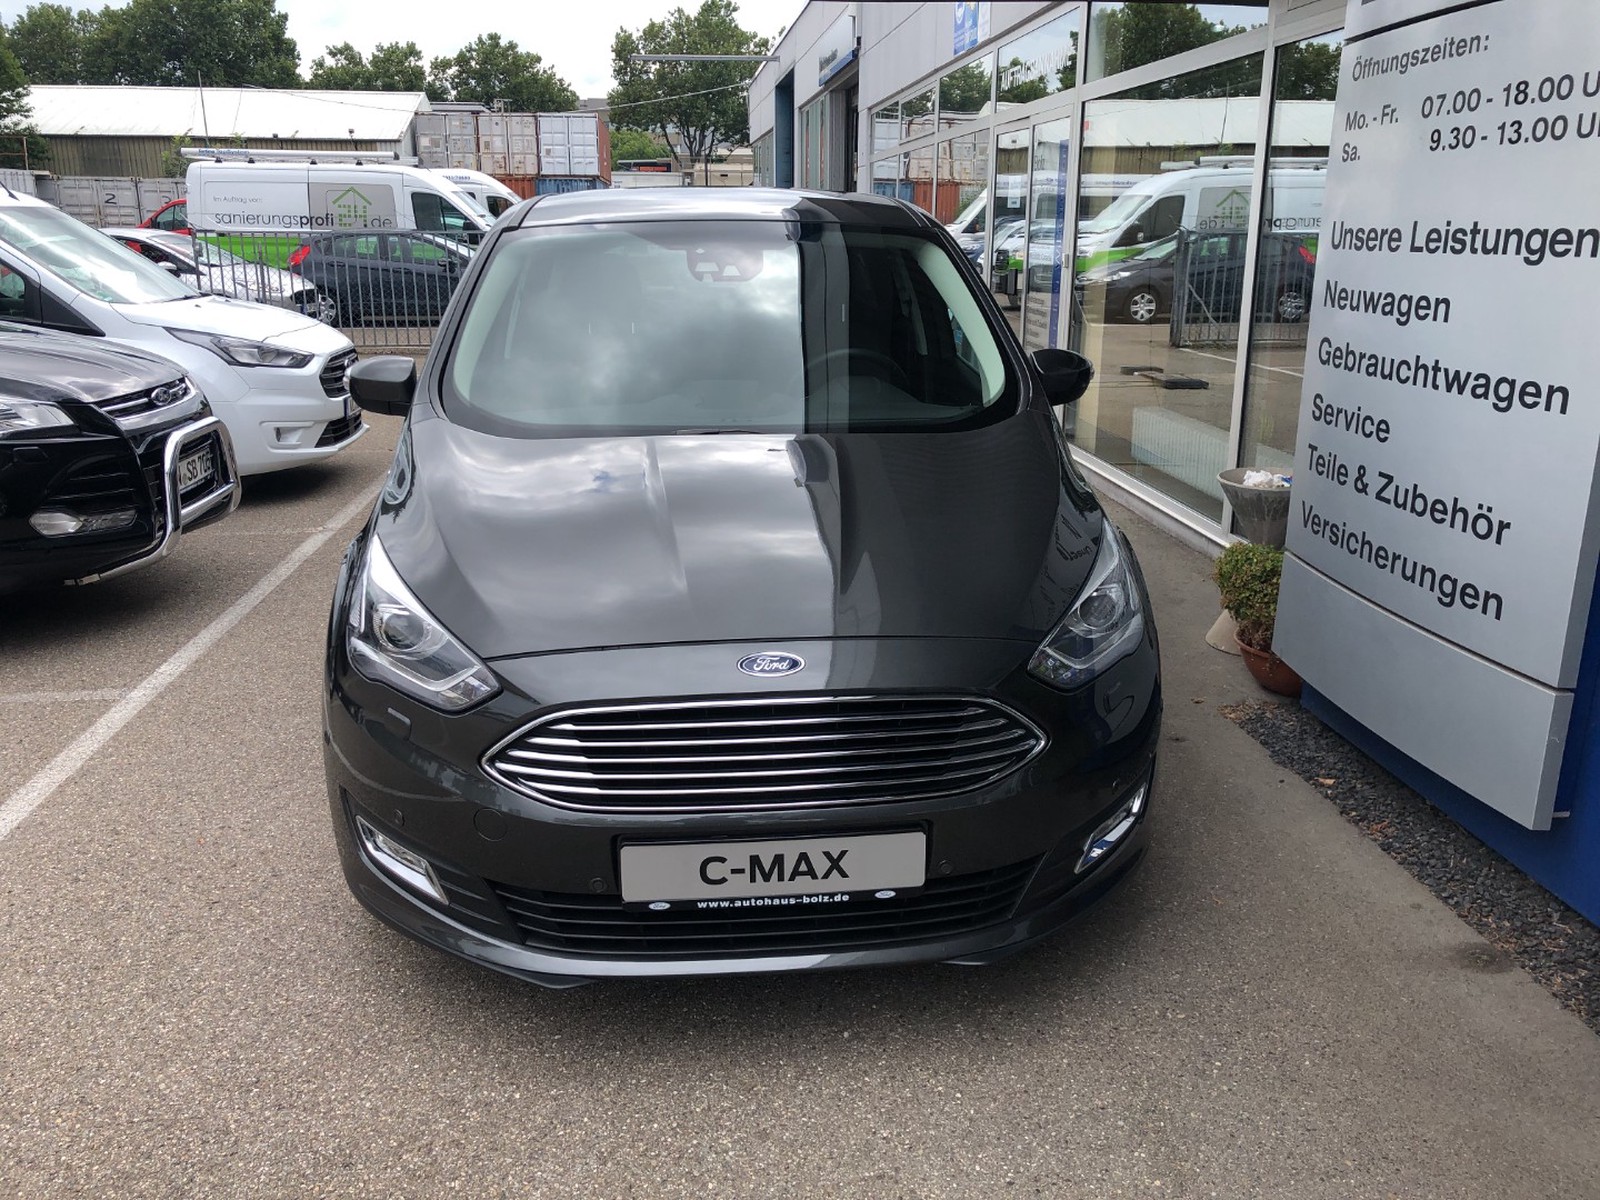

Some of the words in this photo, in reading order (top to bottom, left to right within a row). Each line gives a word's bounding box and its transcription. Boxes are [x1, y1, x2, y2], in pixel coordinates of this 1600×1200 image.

[1352, 34, 1490, 82] Öffnungszeiten:
[1345, 111, 1369, 132] Mo.
[1381, 104, 1399, 126] Fr.
[1421, 88, 1482, 119] 07.00
[1502, 74, 1575, 108] 18.00
[1342, 142, 1361, 163] Sa.
[1430, 125, 1477, 152] 9.30
[1497, 114, 1569, 145] 13.00
[104, 193, 117, 205] 2
[1331, 220, 1402, 253] Unsere
[1409, 220, 1600, 267] Leistungen
[1323, 279, 1451, 327] Neuwagen
[1318, 336, 1571, 416] Gebrauchtwagen
[1311, 392, 1391, 444] Service
[1308, 443, 1349, 487] Teile
[1353, 464, 1369, 497] &
[1374, 471, 1512, 546] Zubehör
[1301, 499, 1504, 622] Versicherungen
[699, 849, 850, 886] C-MAX
[697, 893, 850, 909] www.autohaus-bolz.de
